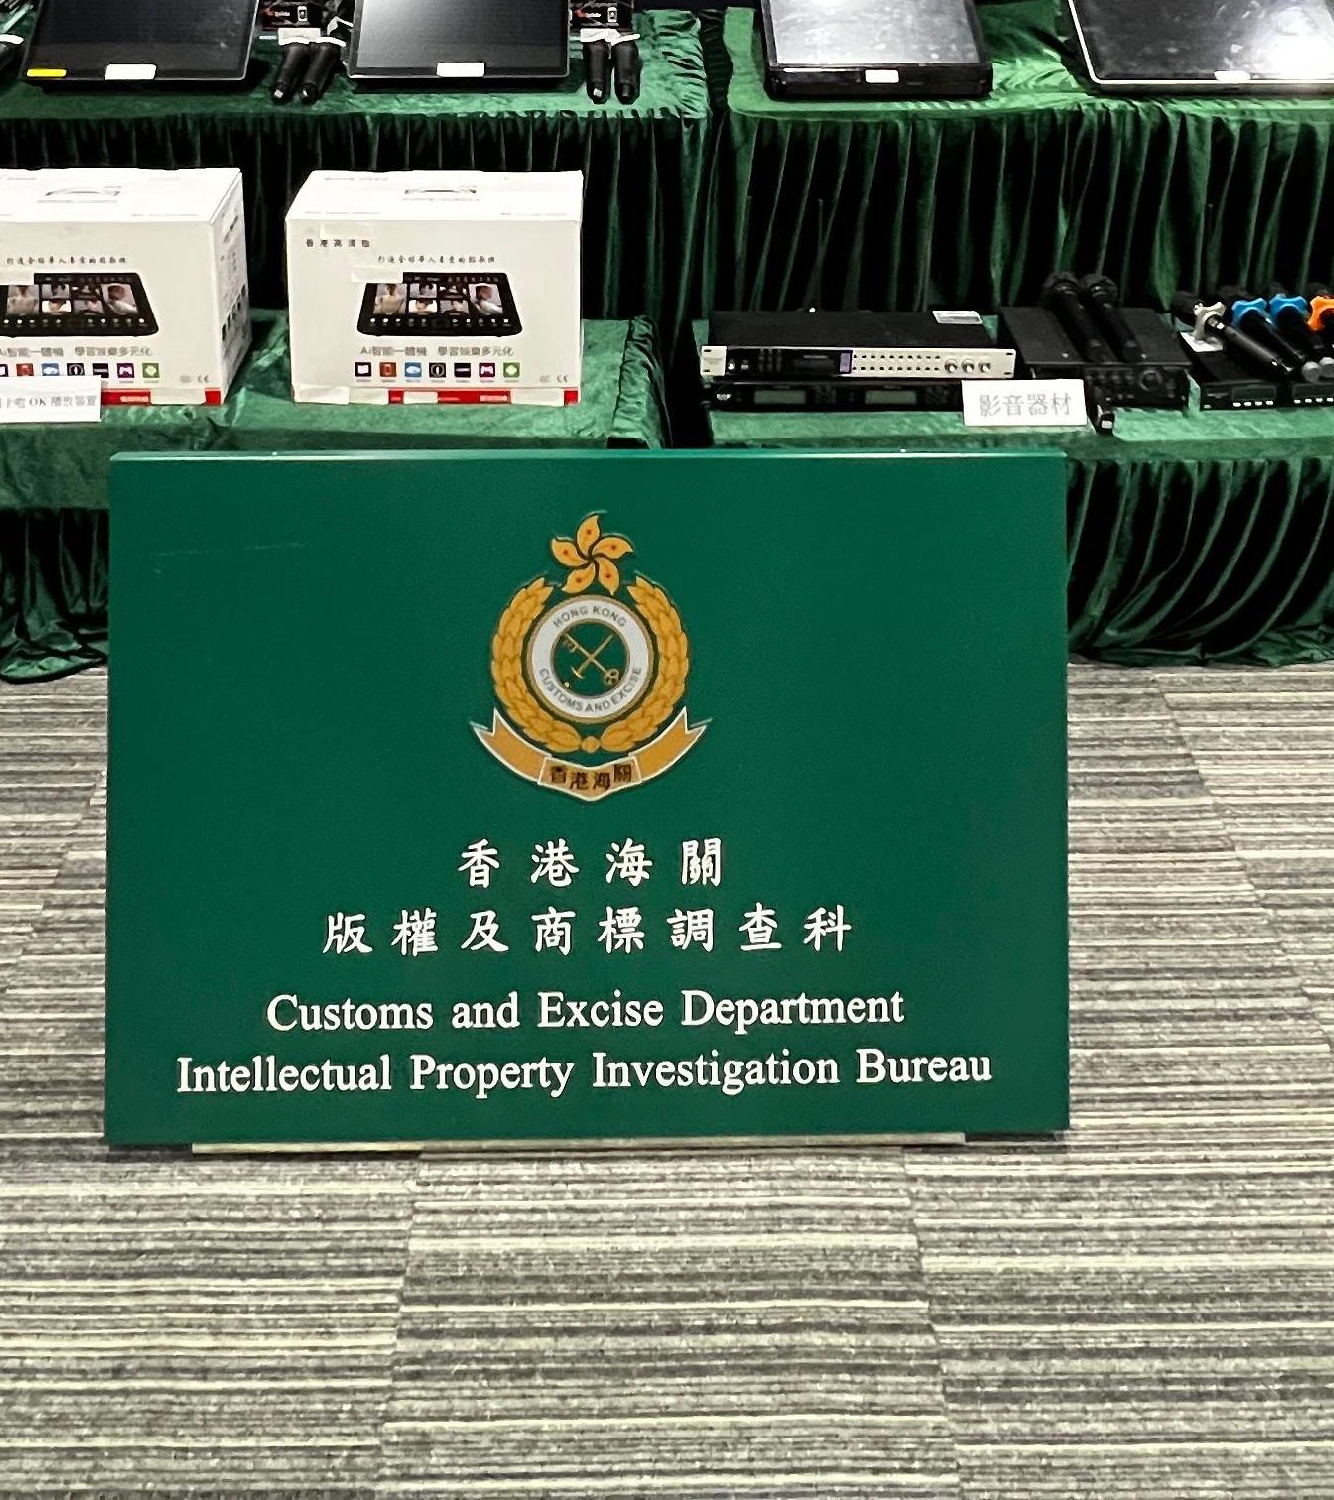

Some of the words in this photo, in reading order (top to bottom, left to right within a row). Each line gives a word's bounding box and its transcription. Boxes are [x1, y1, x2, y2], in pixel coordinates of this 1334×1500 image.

[979, 392, 1072, 417] 影音器材
[552, 606, 589, 629] HONG
[592, 605, 629, 628] KONG
[539, 667, 585, 712] CUSTOMS
[585, 700, 612, 712] AND
[611, 666, 642, 709] EXCISE
[550, 764, 633, 791] 香港海關
[458, 837, 723, 889] 香港海關
[322, 902, 853, 957] 版權及商標調查科
[266, 994, 434, 1032] Customs
[451, 990, 521, 1029] and
[537, 989, 664, 1028] Excise
[681, 989, 905, 1035] Department
[176, 1053, 392, 1093] Intellectual
[409, 1054, 575, 1099] Property
[592, 1048, 841, 1096] Investigation
[855, 1048, 993, 1083] Bureau
